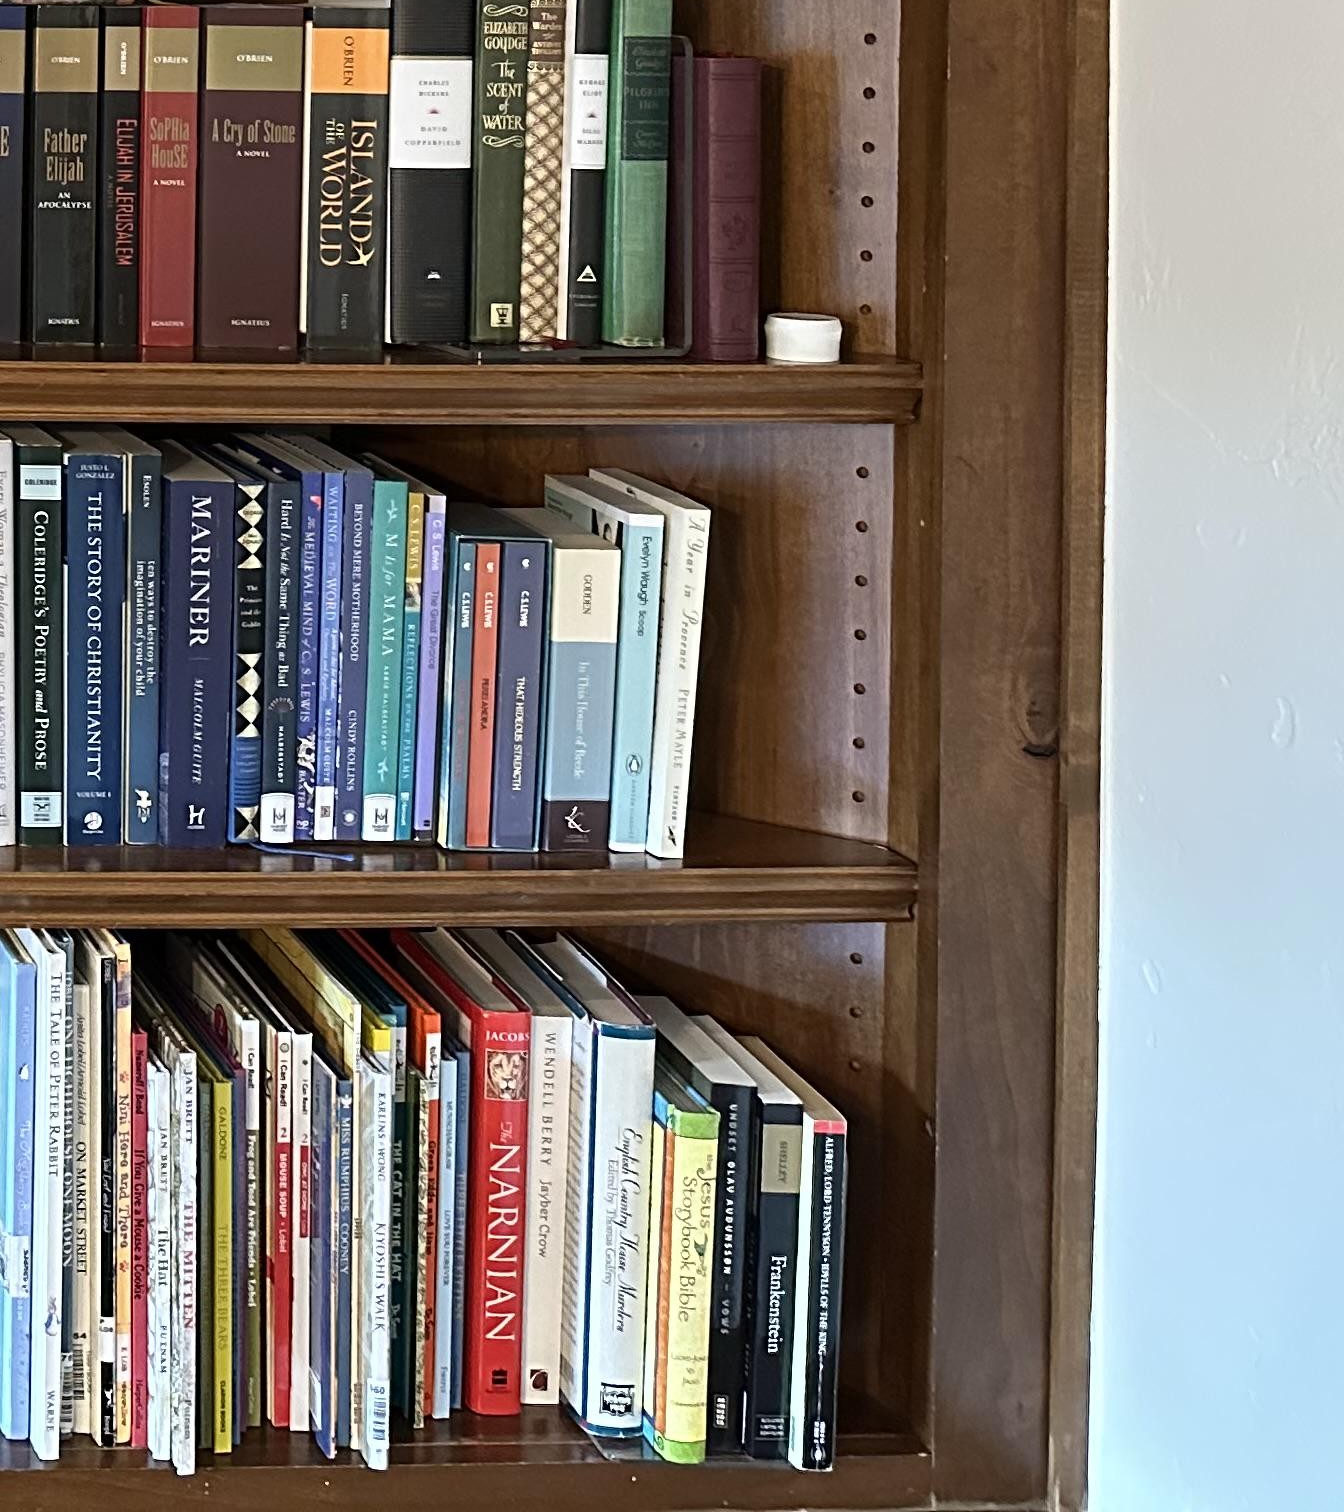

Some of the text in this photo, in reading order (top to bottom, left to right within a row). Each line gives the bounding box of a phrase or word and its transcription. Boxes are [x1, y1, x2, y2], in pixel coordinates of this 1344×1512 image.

[484, 22, 528, 35] ELIZABETH
[485, 36, 527, 54] GOUDGE
[44, 128, 87, 154] Father
[212, 119, 296, 146] A Cry of Stone
[336, 123, 344, 141] OF
[47, 157, 84, 184] Elijah
[320, 118, 345, 266] THE WORLD
[347, 120, 377, 244] ISLAND
[189, 495, 211, 648] MARINER
[86, 492, 102, 782] THE STORY OF CHRISTIANITY
[486, 1030, 529, 1042] JACOBS
[48, 973, 63, 1177] THE TALE OF PETER RABBIT
[485, 1142, 521, 1341] NARNIAN
[767, 1255, 787, 1354] Frankenstein
